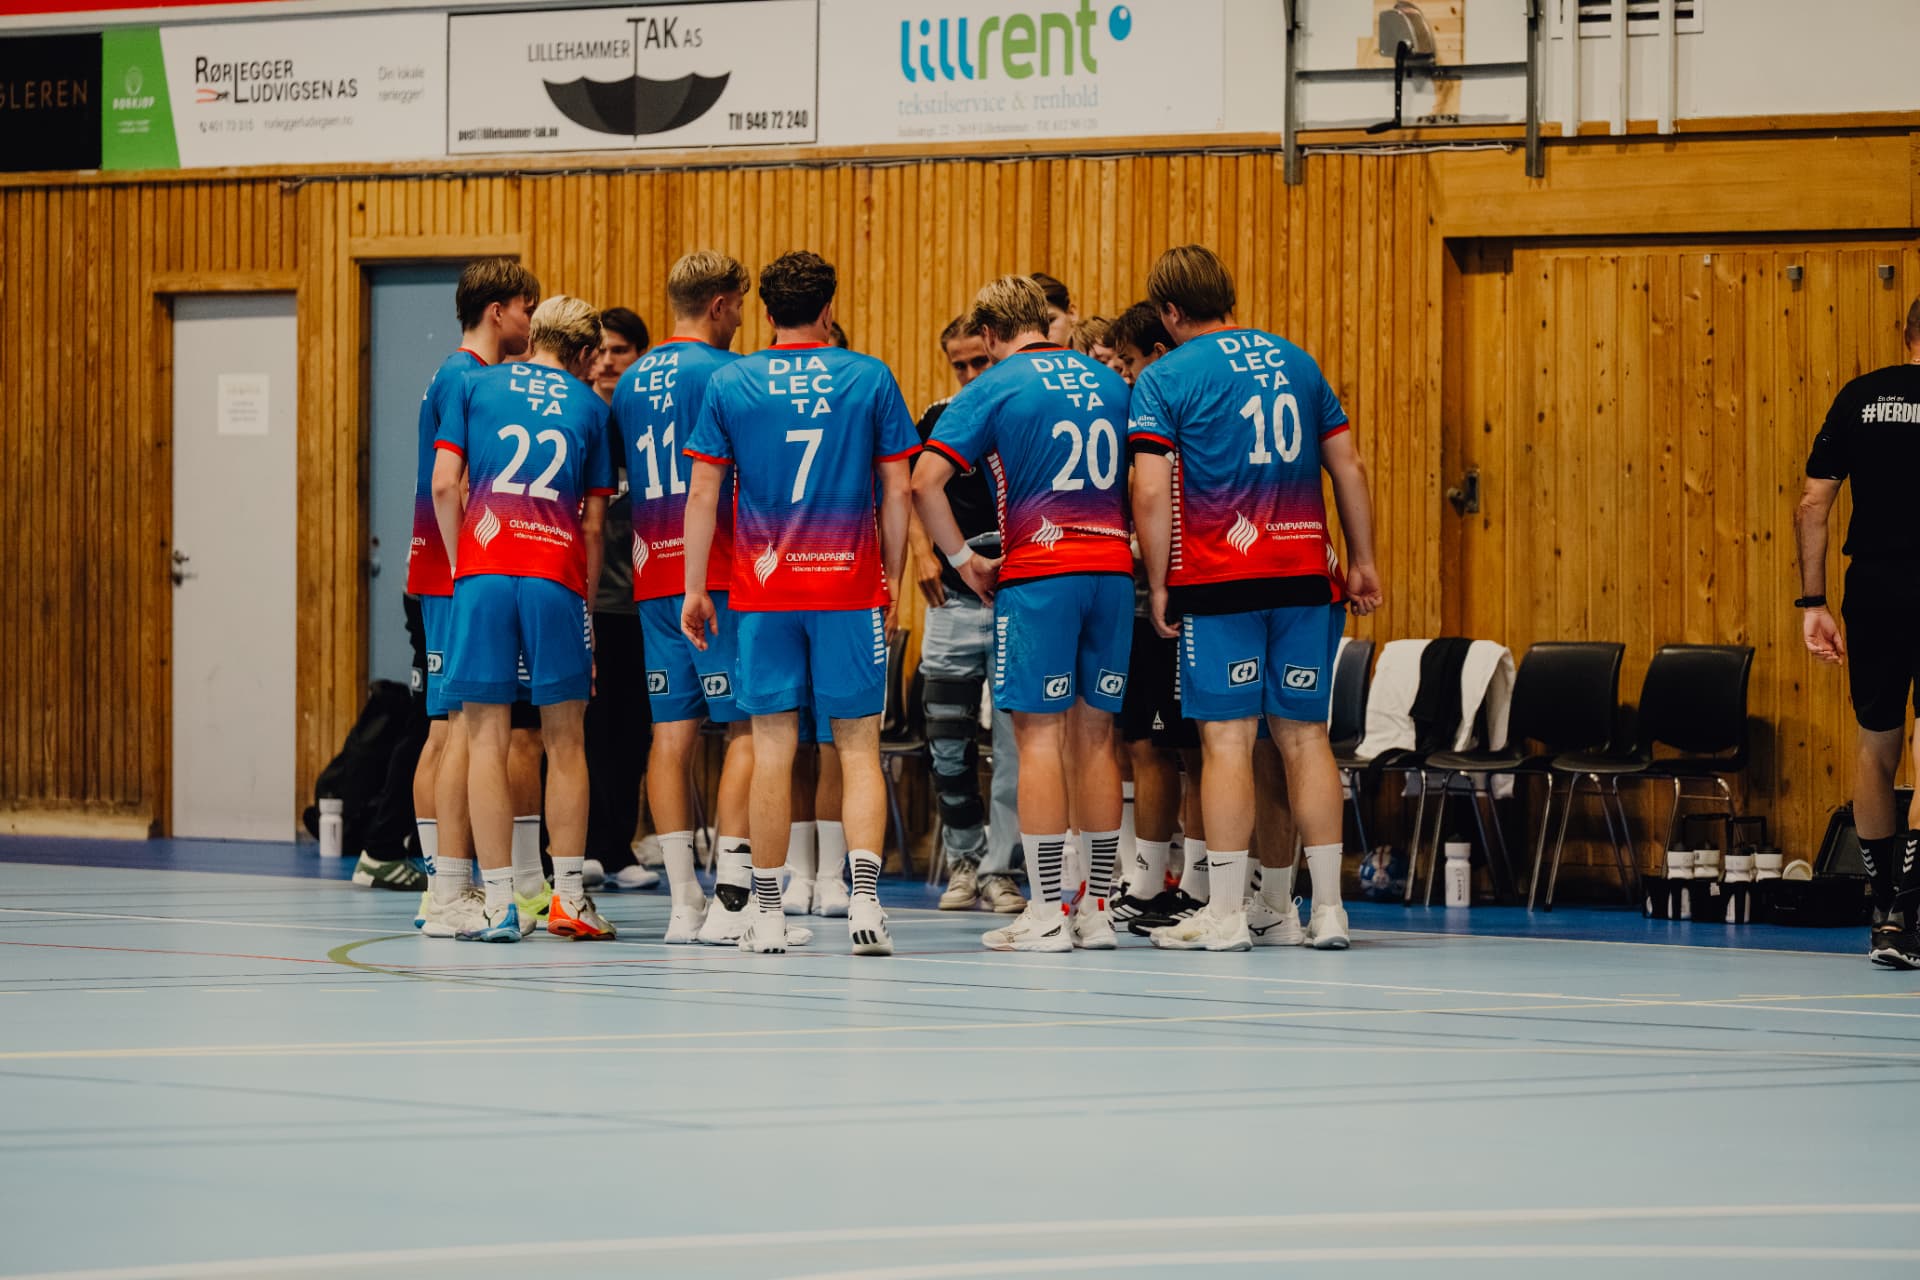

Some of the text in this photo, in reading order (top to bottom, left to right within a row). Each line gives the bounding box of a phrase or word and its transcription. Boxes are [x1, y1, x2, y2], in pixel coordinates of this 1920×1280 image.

[528, 17, 703, 62] LILLEHAMMER TAK AS
[901, 0, 1097, 83] lillrent
[234, 73, 358, 103] LUDVIGSEN AS
[1033, 84, 1099, 110] renhold
[746, 111, 768, 130] 948
[772, 110, 784, 128] 72
[787, 109, 808, 128] 240
[1216, 334, 1274, 355] DIA
[638, 352, 679, 372] DIA
[768, 355, 828, 375] DIA
[1030, 356, 1087, 373] DIA
[1229, 348, 1285, 373] LEC
[510, 378, 568, 398] LEC
[634, 368, 678, 393] LEC
[768, 374, 834, 395] LEC
[1041, 371, 1100, 391] LEC
[1253, 370, 1290, 391] TA
[527, 397, 562, 416] TA
[649, 391, 674, 413] TA
[791, 397, 832, 418] TA
[1066, 391, 1104, 412] TA
[1861, 402, 1920, 423] #VERDI
[1239, 393, 1303, 465] 10
[491, 424, 567, 502] 22
[636, 421, 687, 500] 11
[1051, 418, 1119, 491] 20
[785, 429, 824, 504] 7
